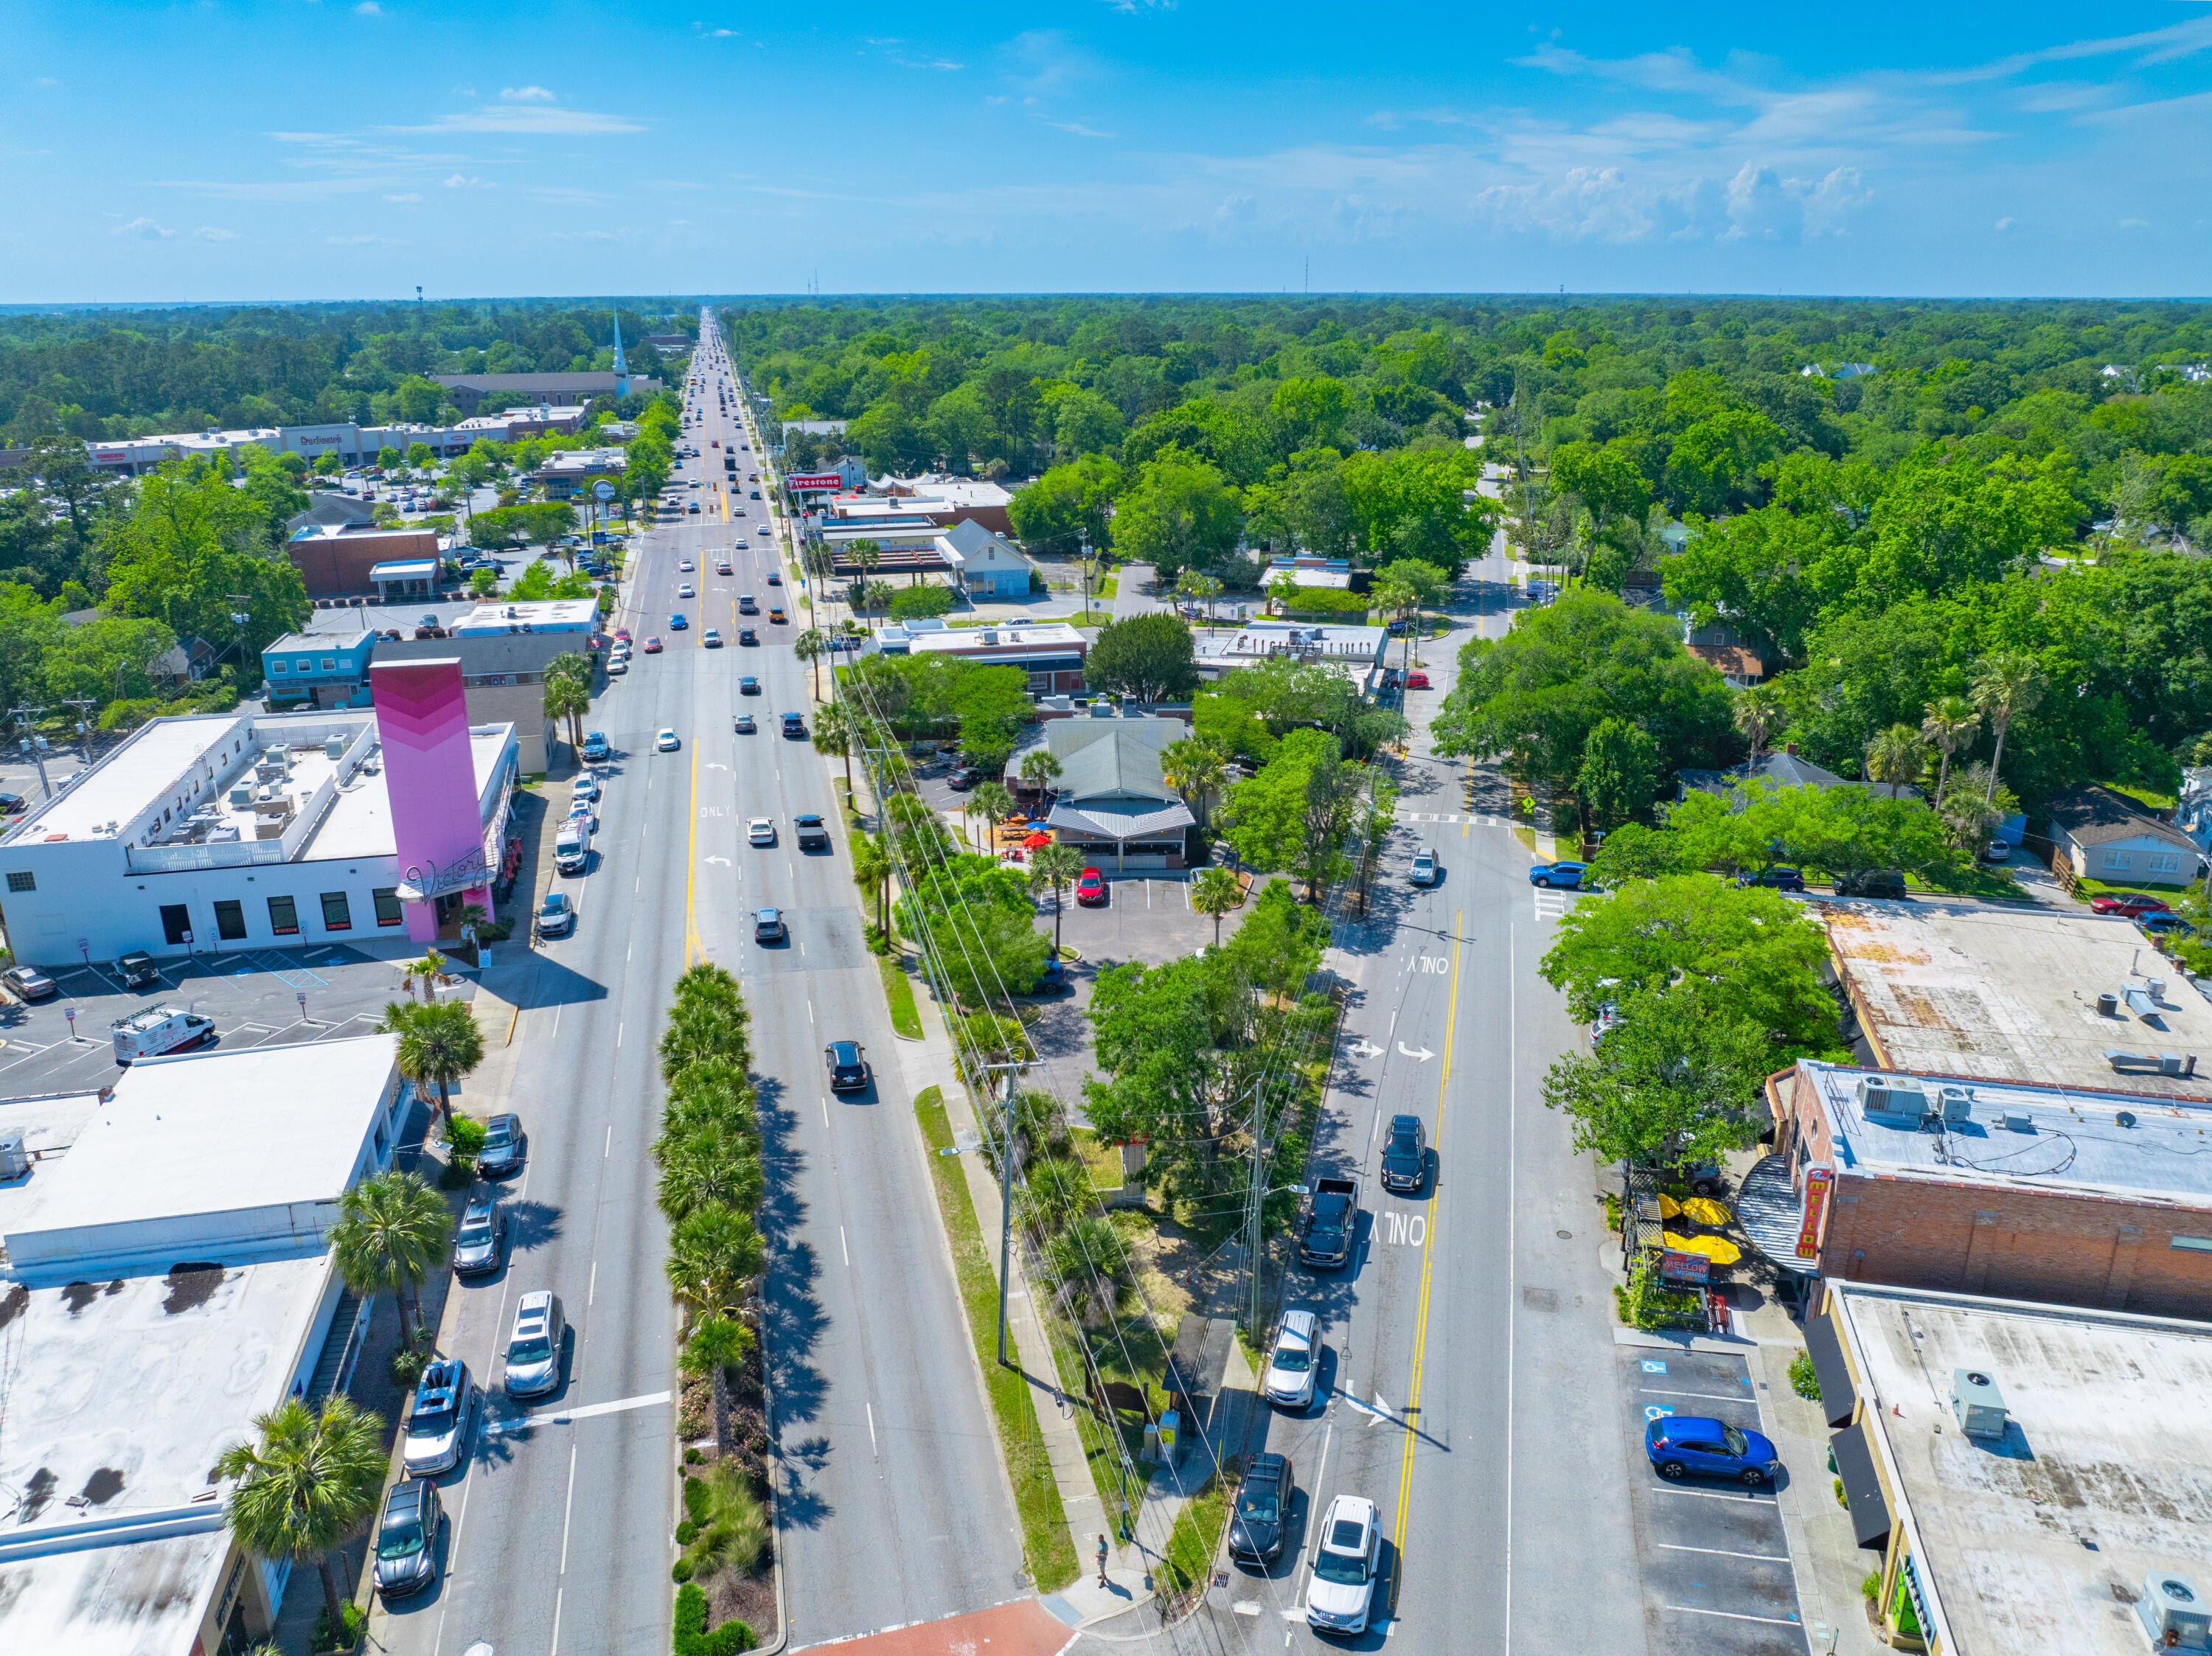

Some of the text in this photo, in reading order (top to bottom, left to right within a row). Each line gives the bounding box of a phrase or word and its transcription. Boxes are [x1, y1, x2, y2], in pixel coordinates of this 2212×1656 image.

[700, 805, 731, 818] ONLY
[406, 847, 497, 907] Victory
[1406, 955, 1449, 975] ONLY
[1368, 1210, 1426, 1247] ONLY
[1800, 1181, 1826, 1257] MELLOW
[1664, 1260, 1708, 1274] MELLOW
[1676, 1269, 1707, 1278] MUSHROOM
